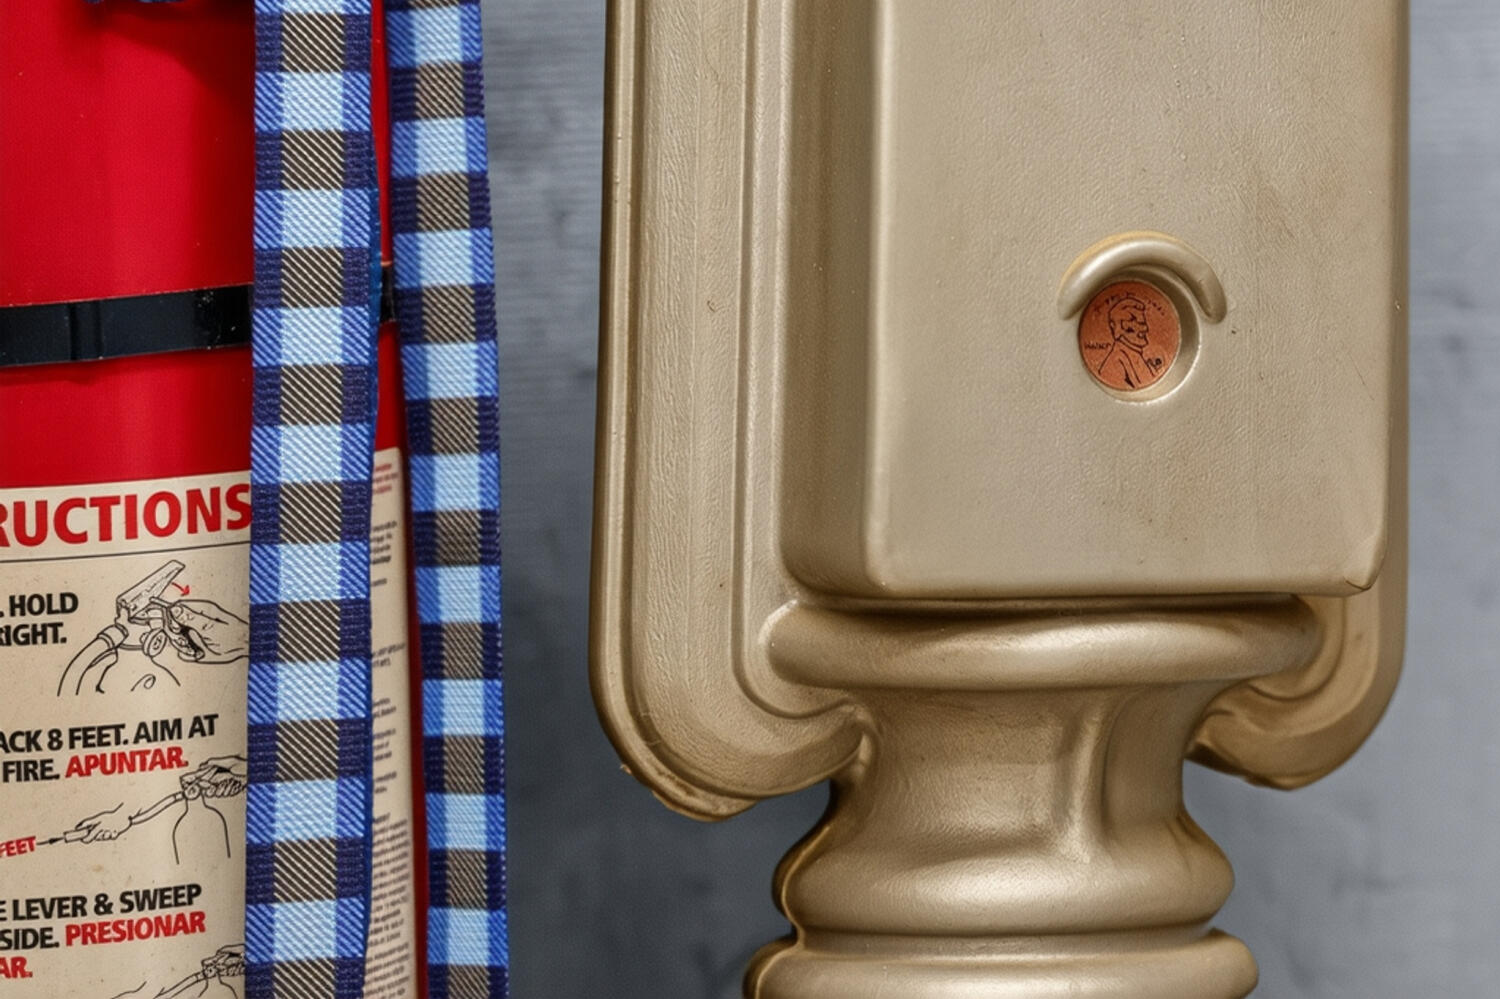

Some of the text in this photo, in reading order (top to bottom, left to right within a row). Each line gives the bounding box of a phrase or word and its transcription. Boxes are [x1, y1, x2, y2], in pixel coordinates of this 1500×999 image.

[9, 592, 79, 618] HOLD
[47, 728, 63, 752] 8
[68, 723, 129, 750] FEET.
[133, 718, 183, 745] AIM
[188, 714, 219, 739] AT
[2, 746, 189, 783] FIRE. APUNTAR.
[12, 895, 88, 921] LEVER
[94, 892, 113, 916] &
[119, 883, 202, 913] SWEEP
[65, 911, 206, 947] PRESIONAR
